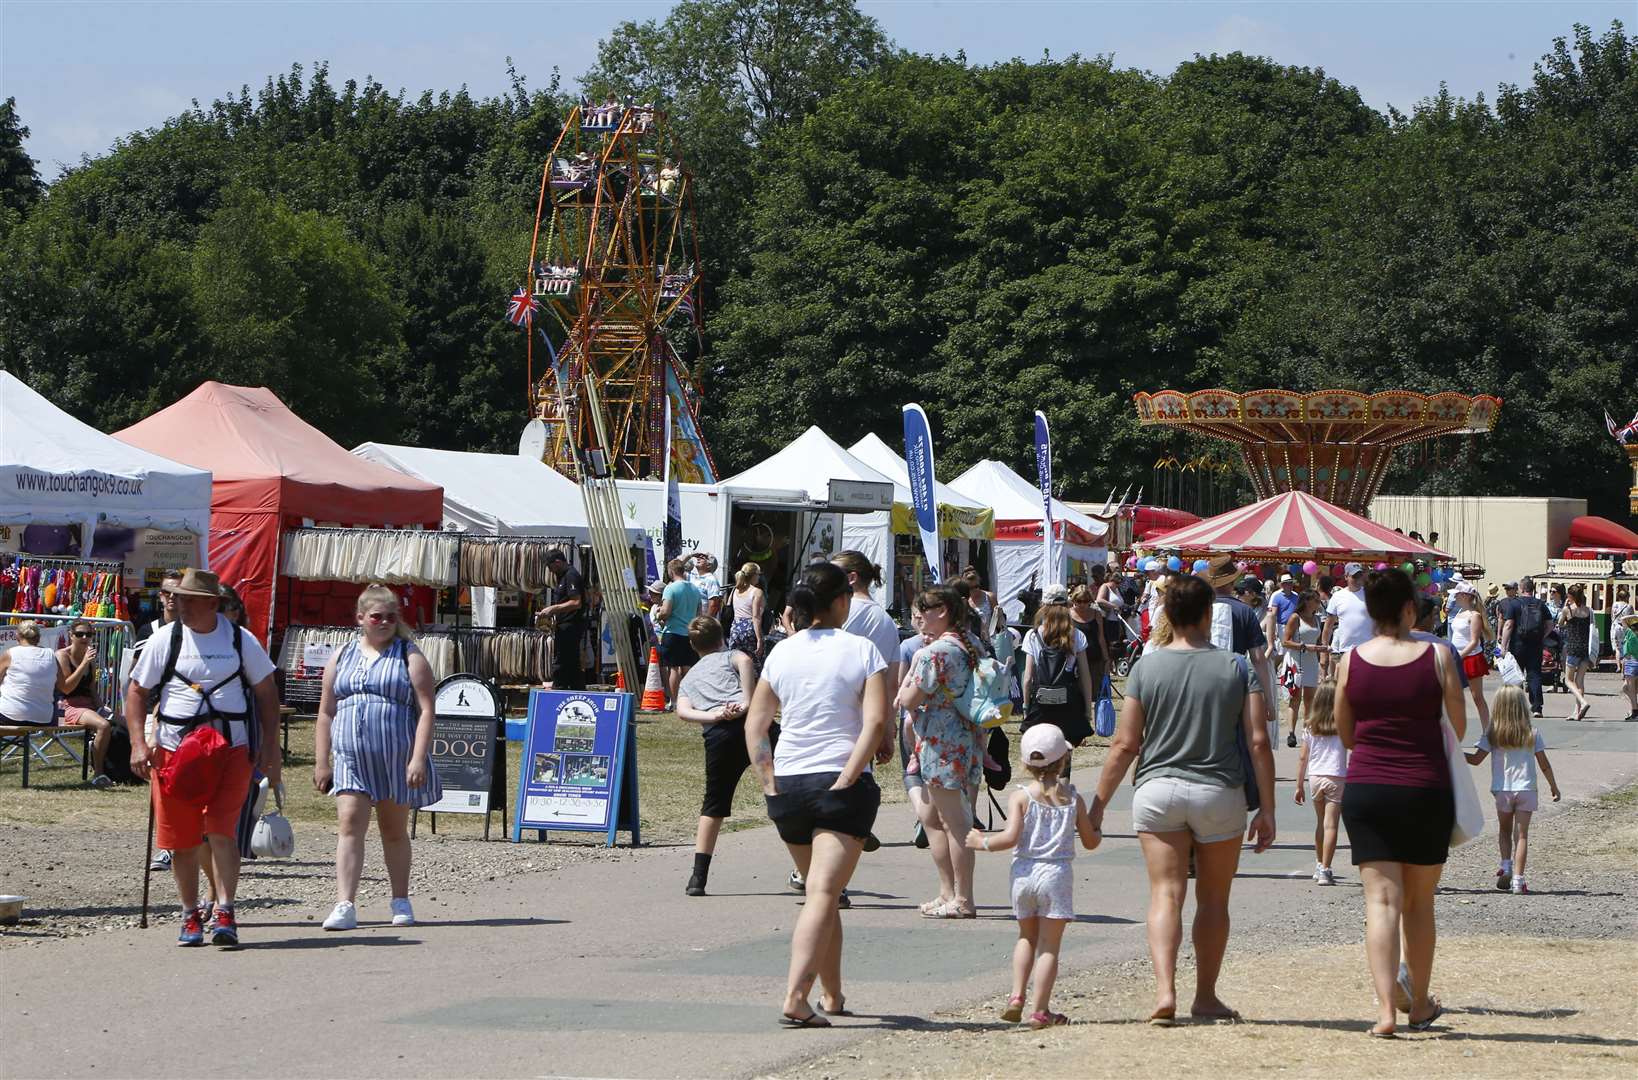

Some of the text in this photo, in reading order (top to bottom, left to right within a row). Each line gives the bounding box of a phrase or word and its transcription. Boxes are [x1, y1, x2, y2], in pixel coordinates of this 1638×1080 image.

[16, 472, 144, 497] www.touchangok9.co.uk
[556, 700, 566, 712] THE
[586, 698, 600, 713] SHOW
[432, 739, 487, 758] DOG
